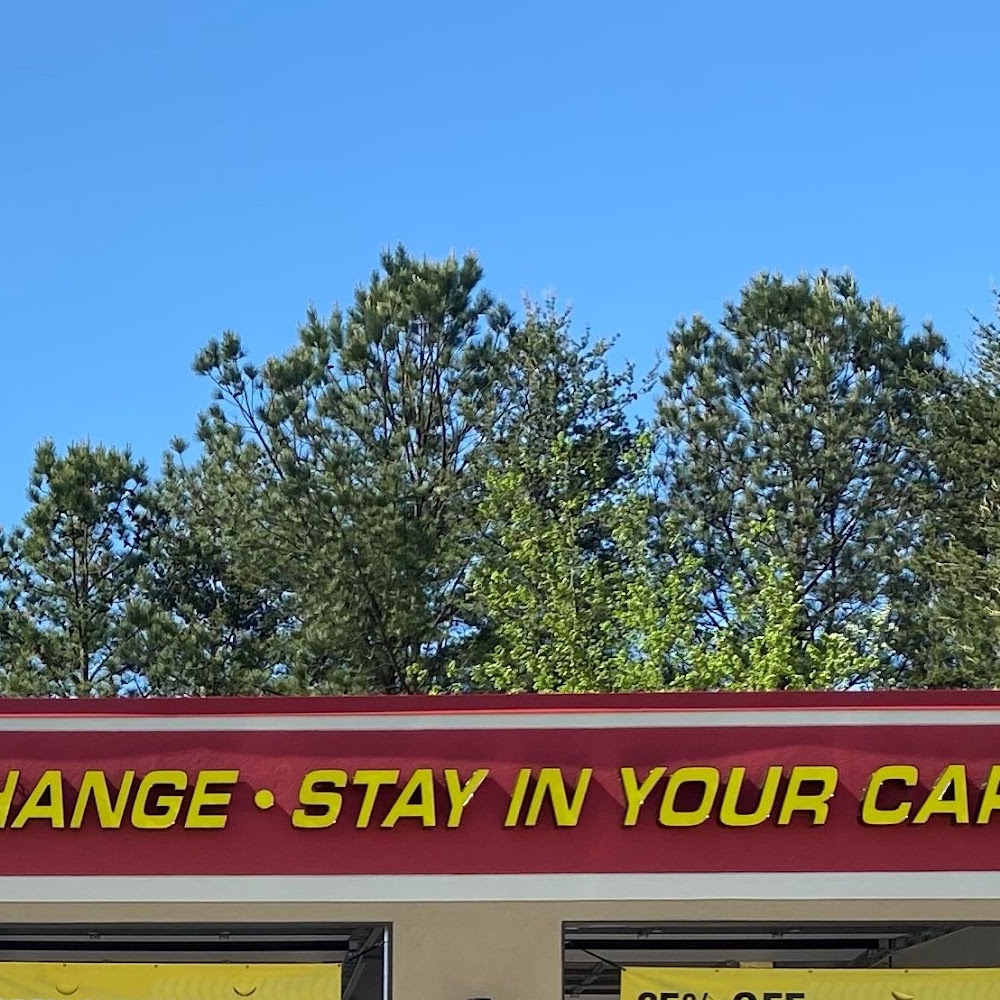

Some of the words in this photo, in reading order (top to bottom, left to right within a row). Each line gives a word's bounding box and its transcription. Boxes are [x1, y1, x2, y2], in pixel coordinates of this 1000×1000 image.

[291, 768, 490, 829] STAY
[503, 767, 595, 828] IN
[619, 765, 840, 828] YOUR
